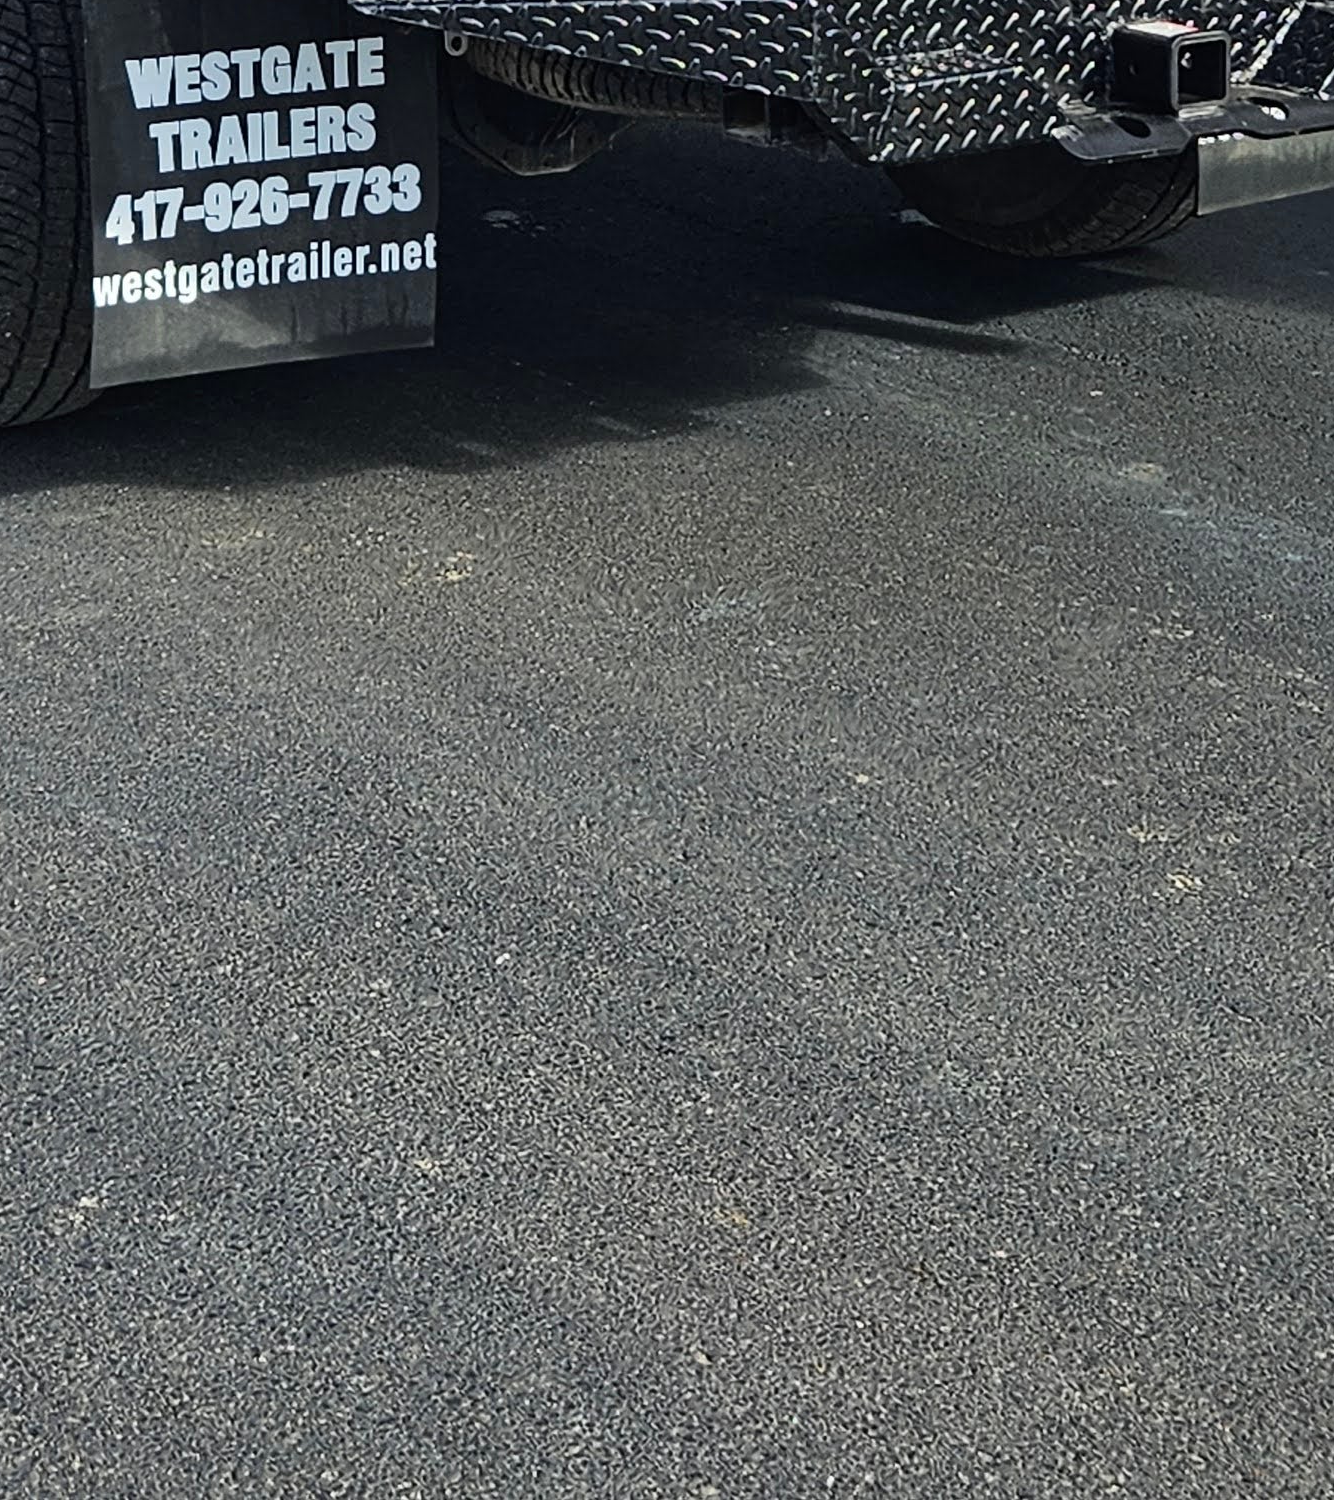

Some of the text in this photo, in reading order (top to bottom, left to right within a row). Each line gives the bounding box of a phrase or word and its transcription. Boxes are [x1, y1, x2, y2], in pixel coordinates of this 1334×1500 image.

[125, 36, 385, 109] WESTGATE
[149, 102, 377, 173] TRAILERS
[105, 163, 422, 246] 417-926-7733
[92, 232, 438, 308] westgatetrailer.net
